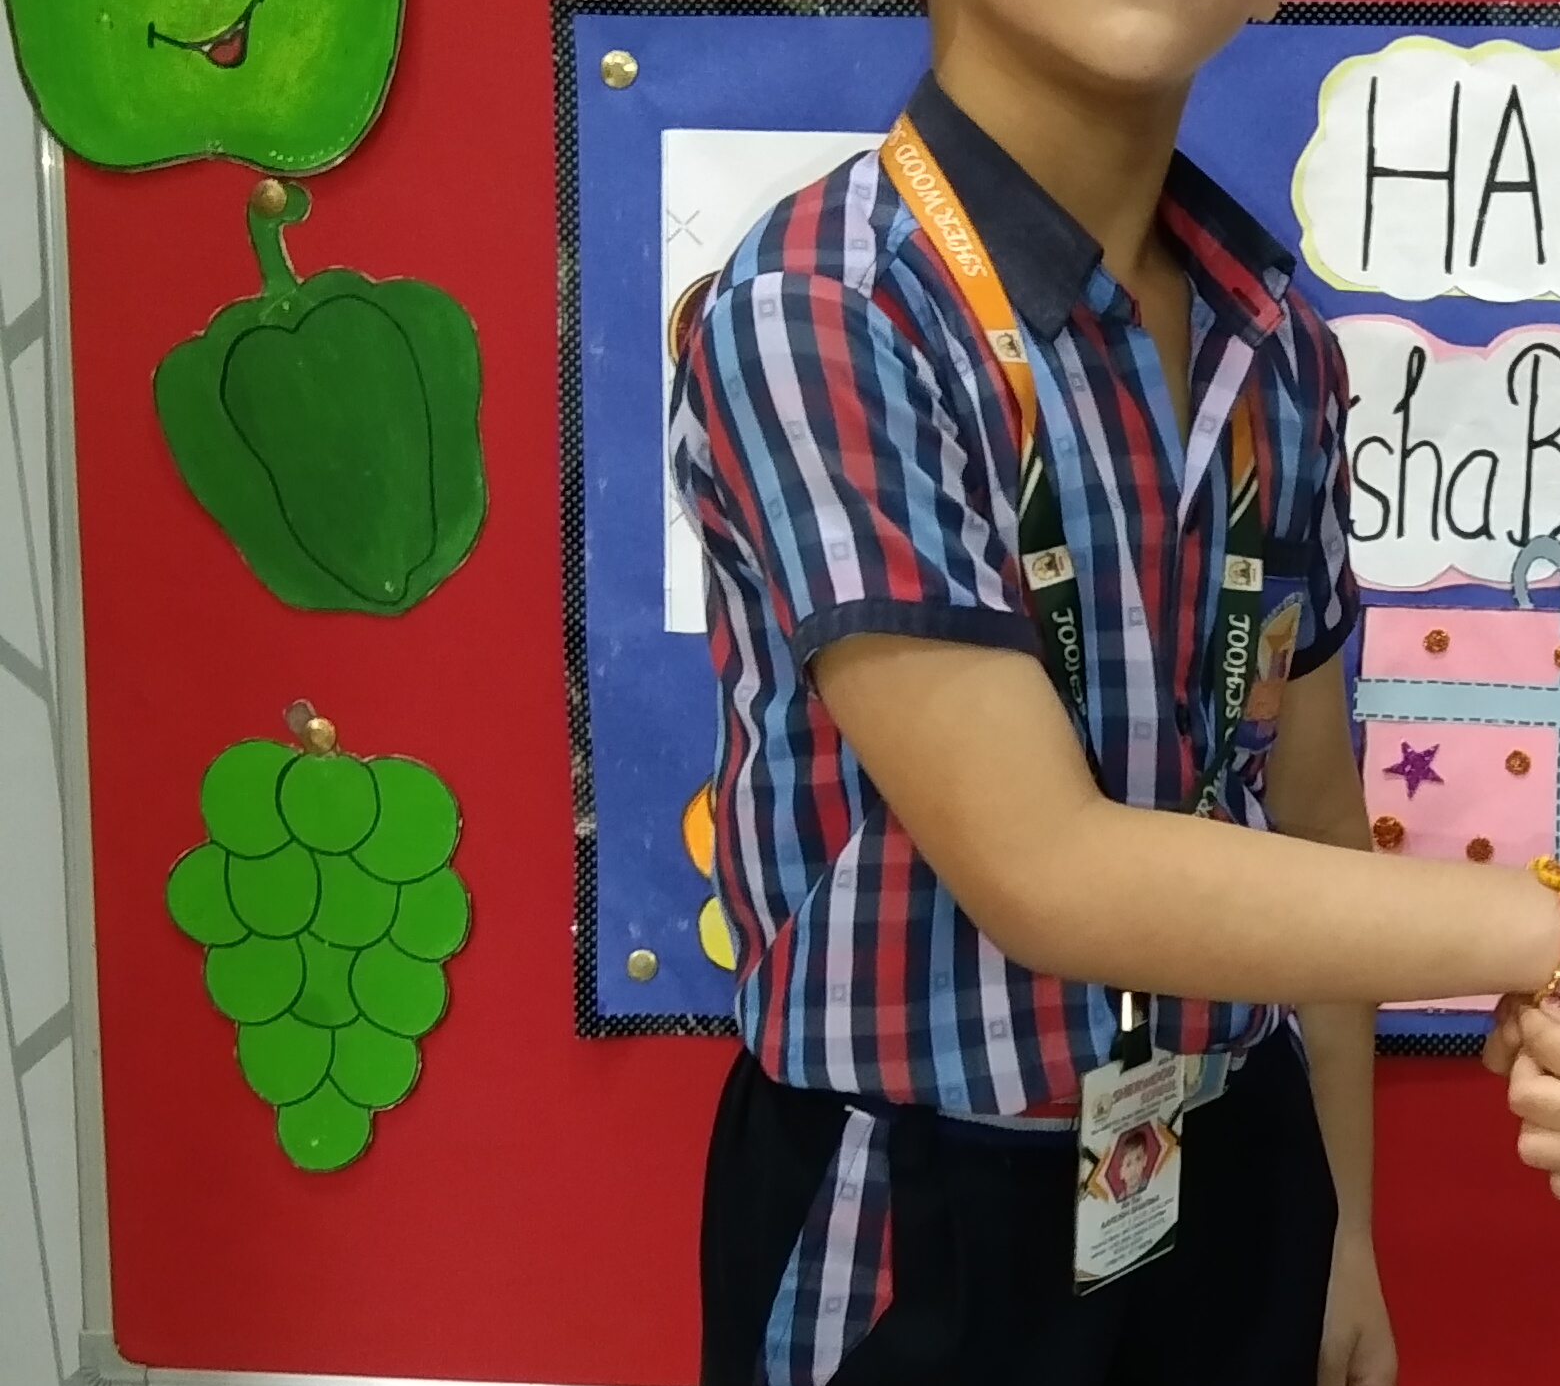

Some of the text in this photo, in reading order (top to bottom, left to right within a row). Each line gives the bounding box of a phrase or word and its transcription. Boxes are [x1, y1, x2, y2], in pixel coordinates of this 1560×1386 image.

[895, 144, 988, 277] SHERWOOD
[1349, 346, 1496, 541] sha
[1222, 613, 1251, 720] SCHOOL
